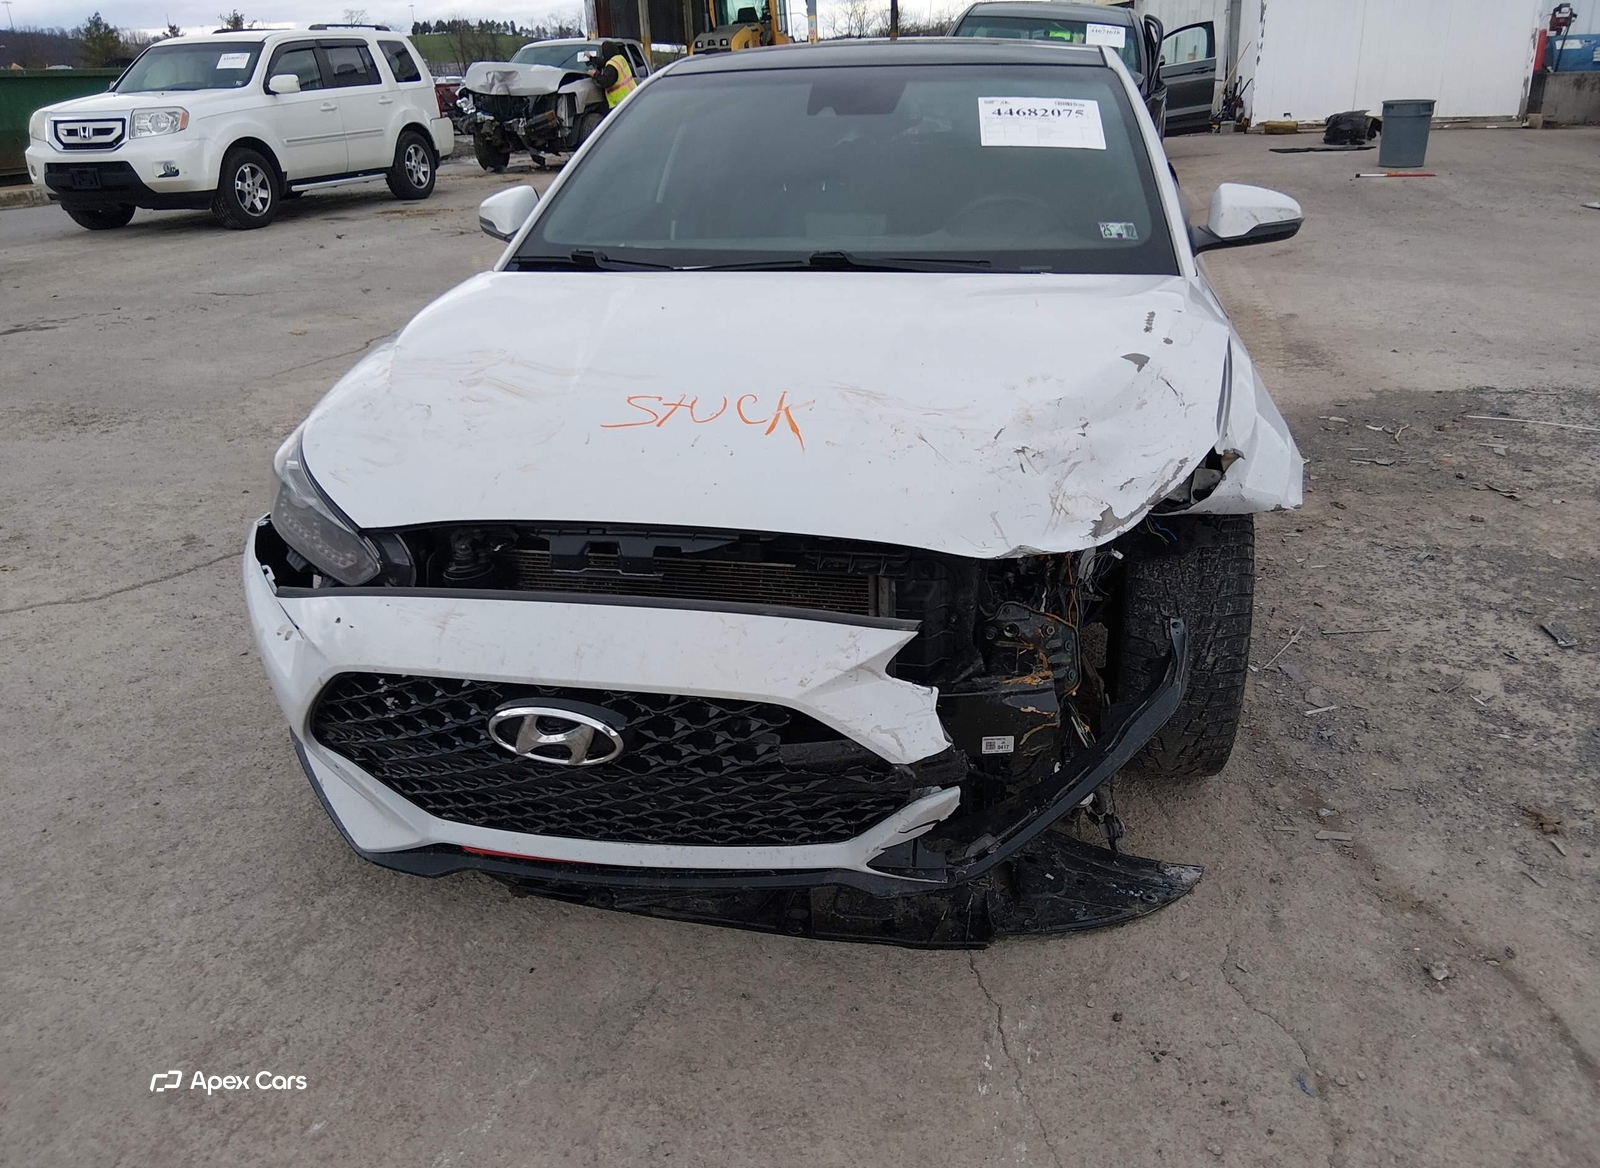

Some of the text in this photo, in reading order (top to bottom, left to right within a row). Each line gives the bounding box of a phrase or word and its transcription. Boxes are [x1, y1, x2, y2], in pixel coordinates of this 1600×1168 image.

[992, 107, 1084, 119] 44682075
[1101, 223, 1113, 237] 25
[599, 390, 815, 453] STUCK
